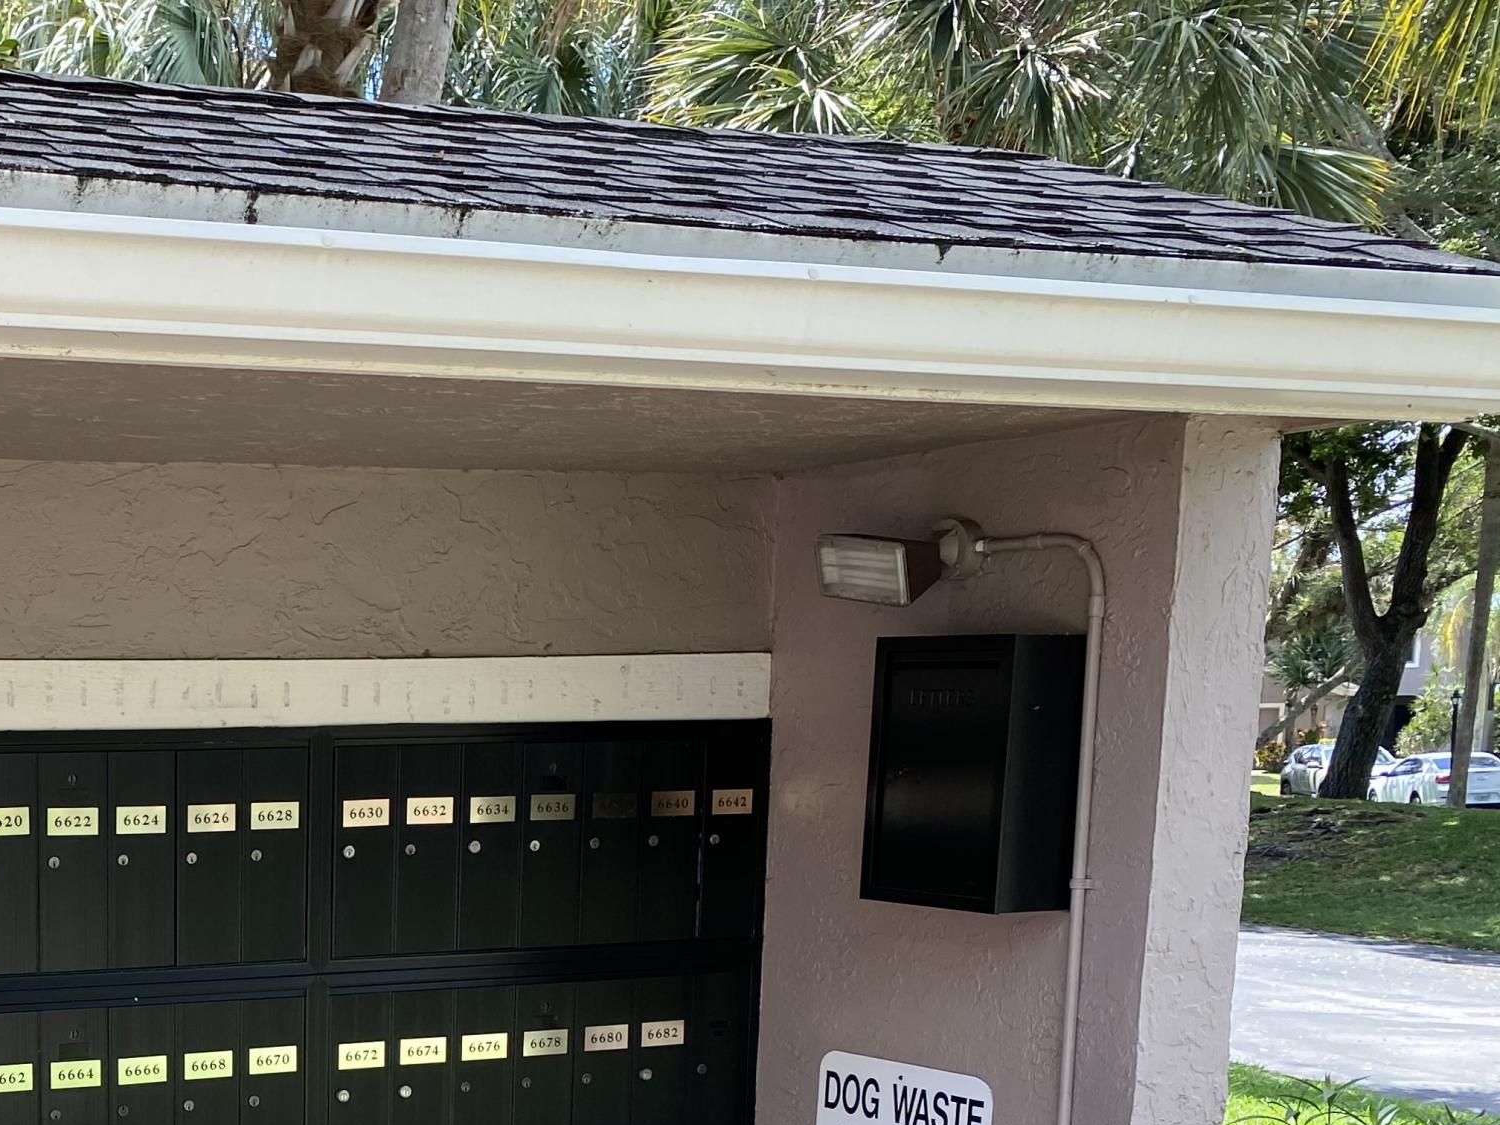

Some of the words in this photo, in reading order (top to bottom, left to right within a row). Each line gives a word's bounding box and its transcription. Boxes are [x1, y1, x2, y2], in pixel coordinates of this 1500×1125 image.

[536, 800, 570, 814] 6636
[656, 796, 689, 810] 6640
[717, 796, 747, 808] 6642
[257, 809, 293, 822] 6628
[349, 806, 383, 820] 6630
[413, 804, 447, 817] 6632
[476, 802, 509, 817] 6634
[54, 815, 92, 828] 6622
[123, 814, 159, 826] 6624
[194, 811, 229, 825] 6626
[590, 1030, 623, 1045] 6680
[647, 1027, 678, 1040] 6682
[468, 1041, 501, 1053] 6676
[529, 1035, 562, 1049] 6678
[345, 1049, 378, 1062] 6672
[407, 1045, 439, 1057] 6674
[191, 1058, 226, 1072] 6668
[256, 1054, 290, 1067] 6670
[58, 1068, 94, 1081] 6664
[124, 1064, 160, 1077] 6666
[824, 1070, 880, 1119] DOG
